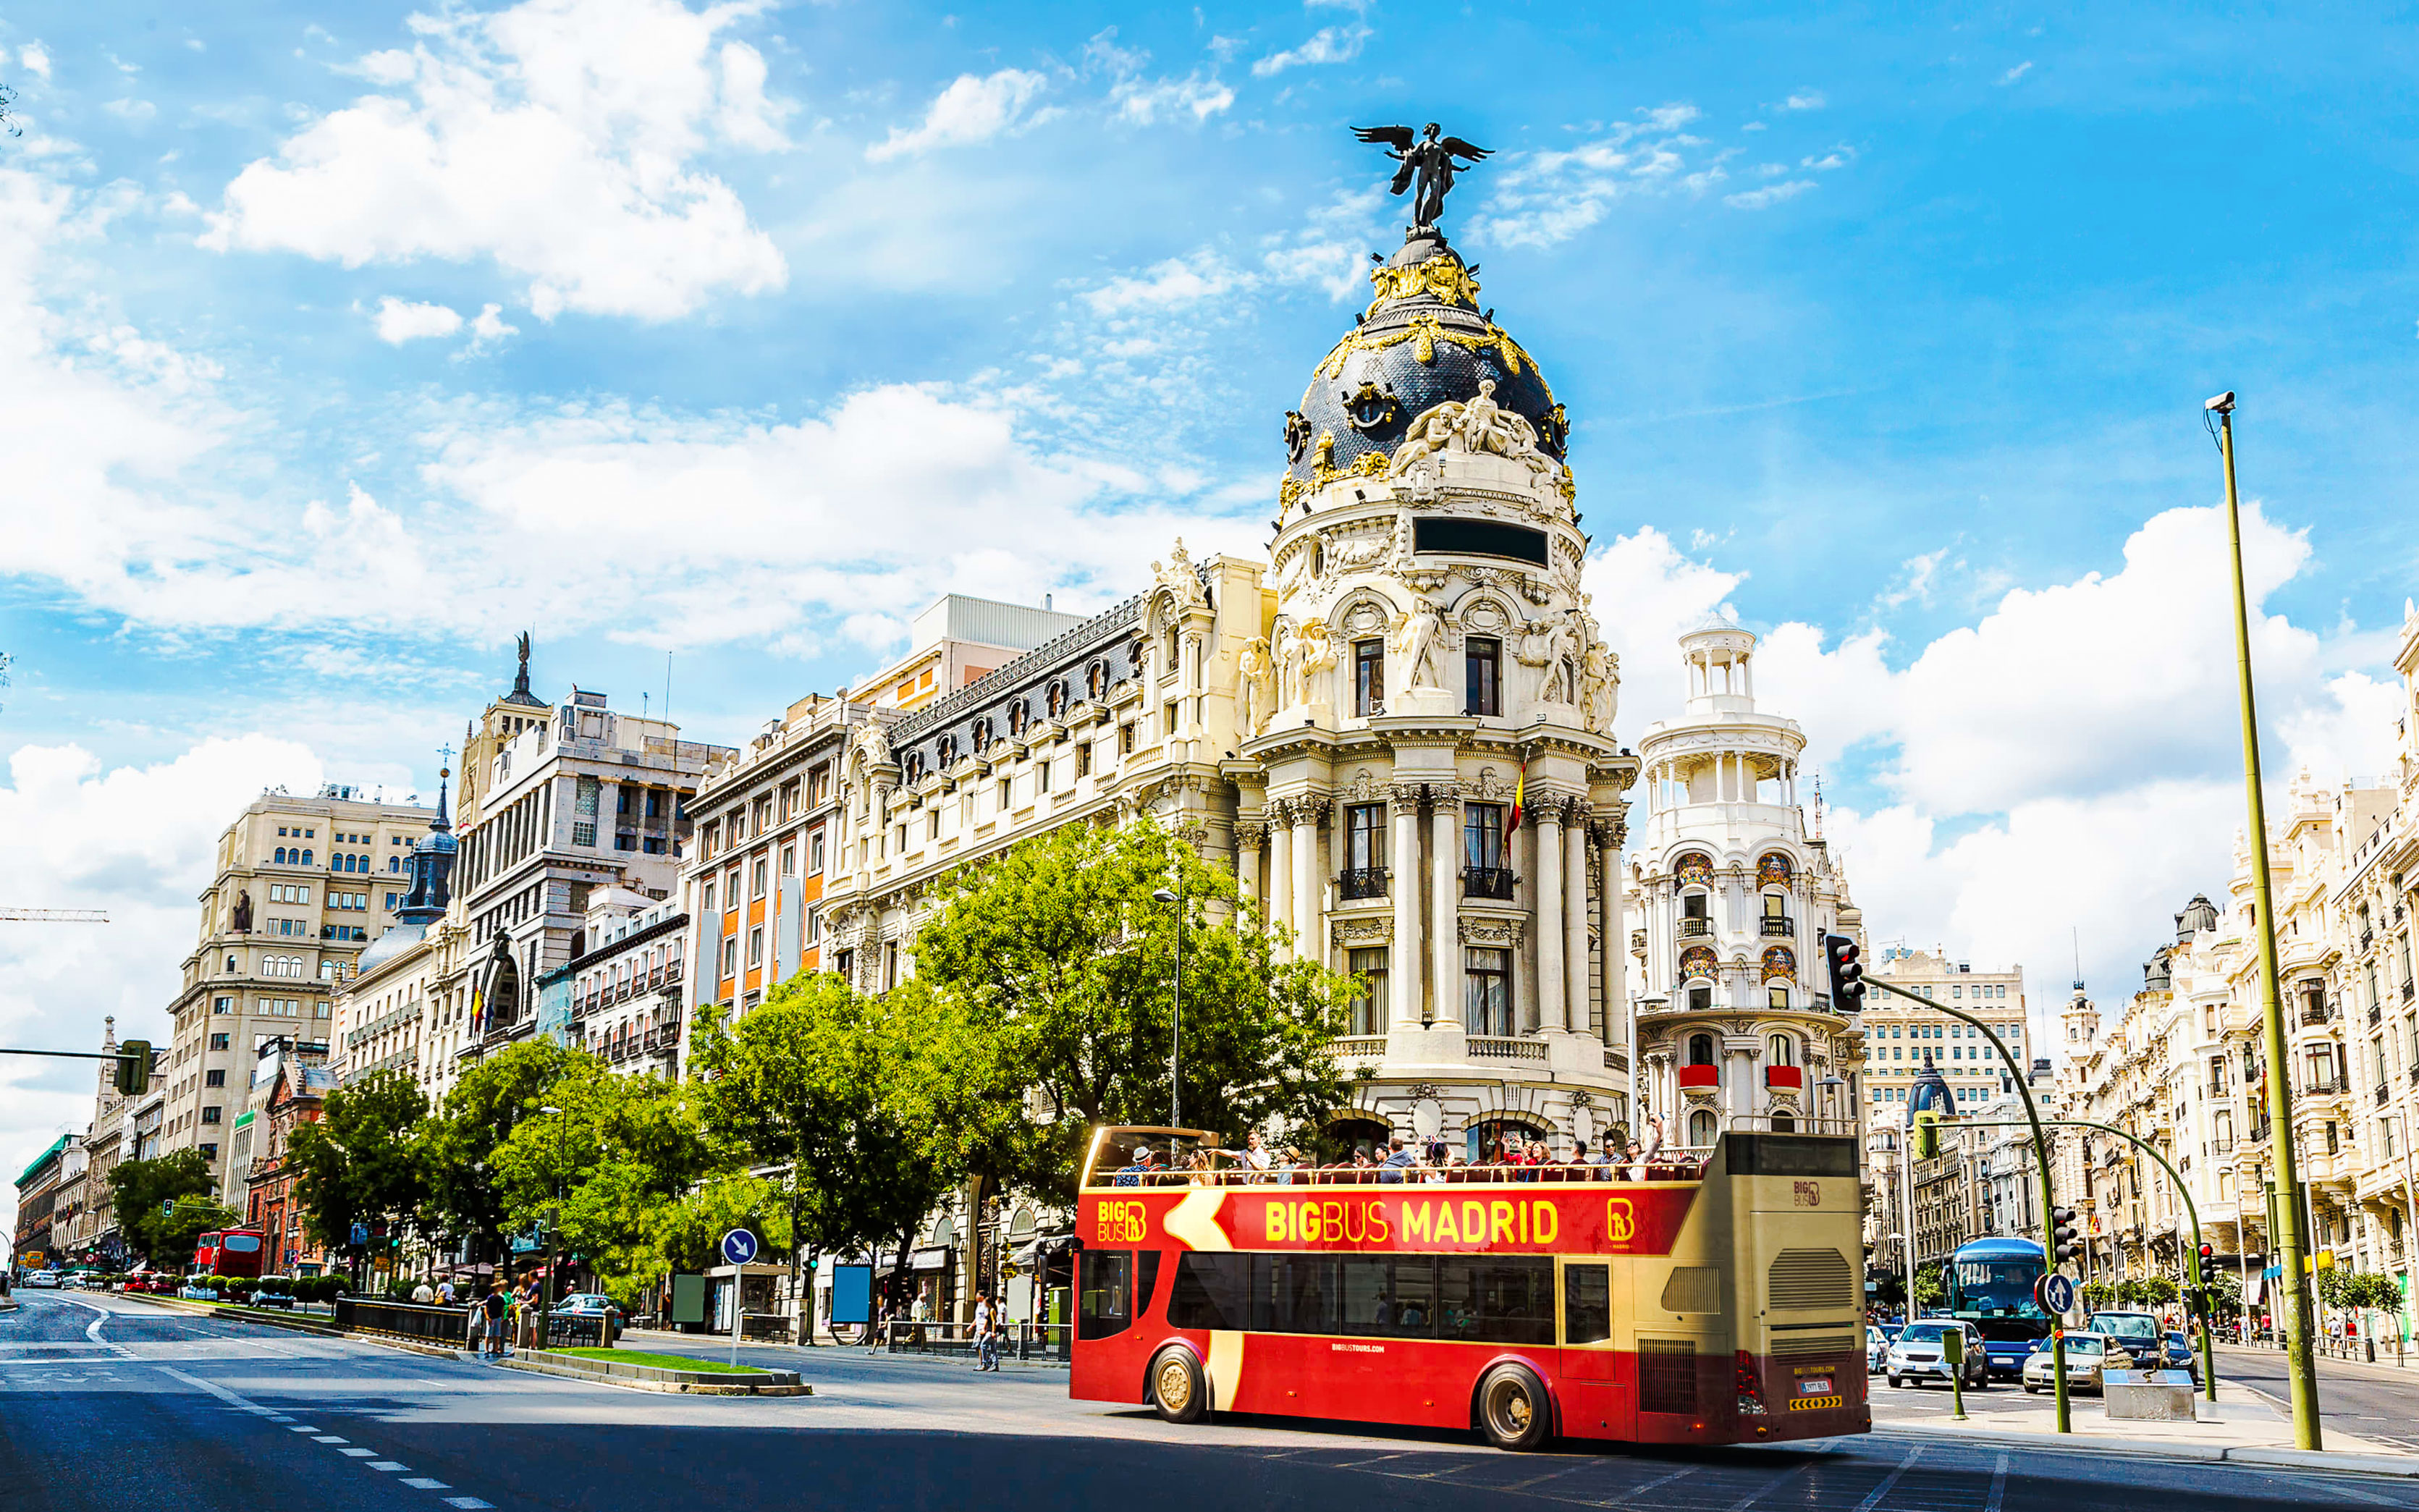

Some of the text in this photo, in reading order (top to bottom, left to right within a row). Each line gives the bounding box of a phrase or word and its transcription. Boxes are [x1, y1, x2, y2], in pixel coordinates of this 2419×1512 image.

[1794, 1181, 1808, 1194] BIG
[1794, 1195, 1809, 1207] BUS
[1098, 1201, 1125, 1222] BIG
[1401, 1201, 1558, 1244] MADRID
[1098, 1222, 1125, 1241] BUS
[1332, 1343, 1385, 1353] BIGBUSTOURS.COM
